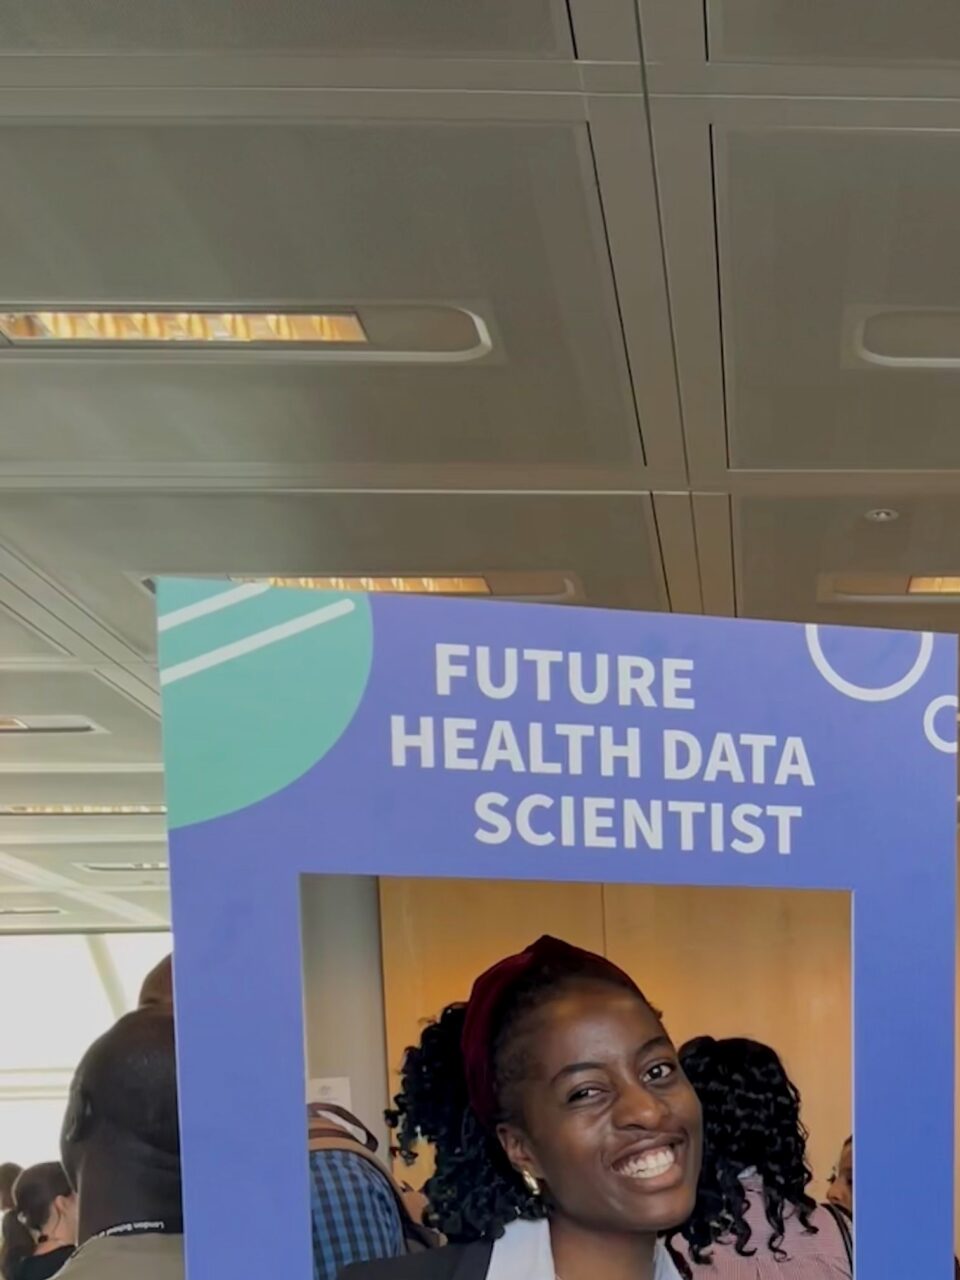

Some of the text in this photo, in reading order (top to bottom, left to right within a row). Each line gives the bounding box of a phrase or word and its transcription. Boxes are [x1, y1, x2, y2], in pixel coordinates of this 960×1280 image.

[435, 643, 695, 710] FUTURE
[390, 715, 815, 786] HEALTH DATA
[474, 792, 802, 854] SCIENTIST
